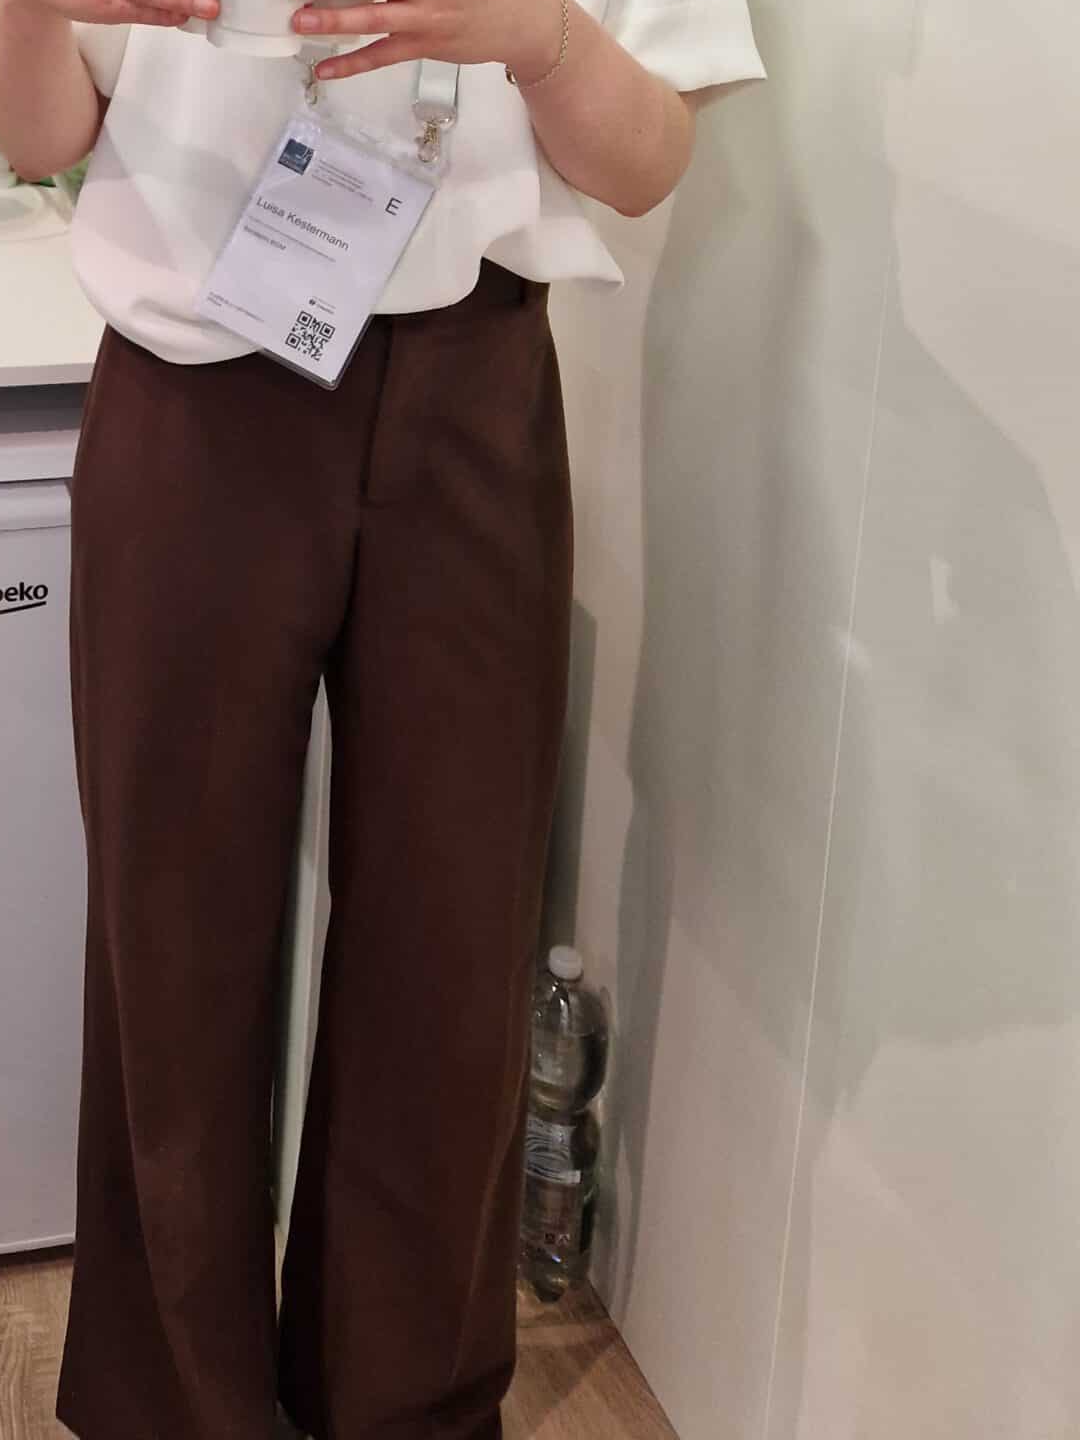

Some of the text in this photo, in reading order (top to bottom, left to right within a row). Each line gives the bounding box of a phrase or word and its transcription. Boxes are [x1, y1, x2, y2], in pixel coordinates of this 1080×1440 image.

[255, 196, 286, 219] Luisa
[286, 210, 350, 252] Kestermann
[385, 197, 403, 216] E
